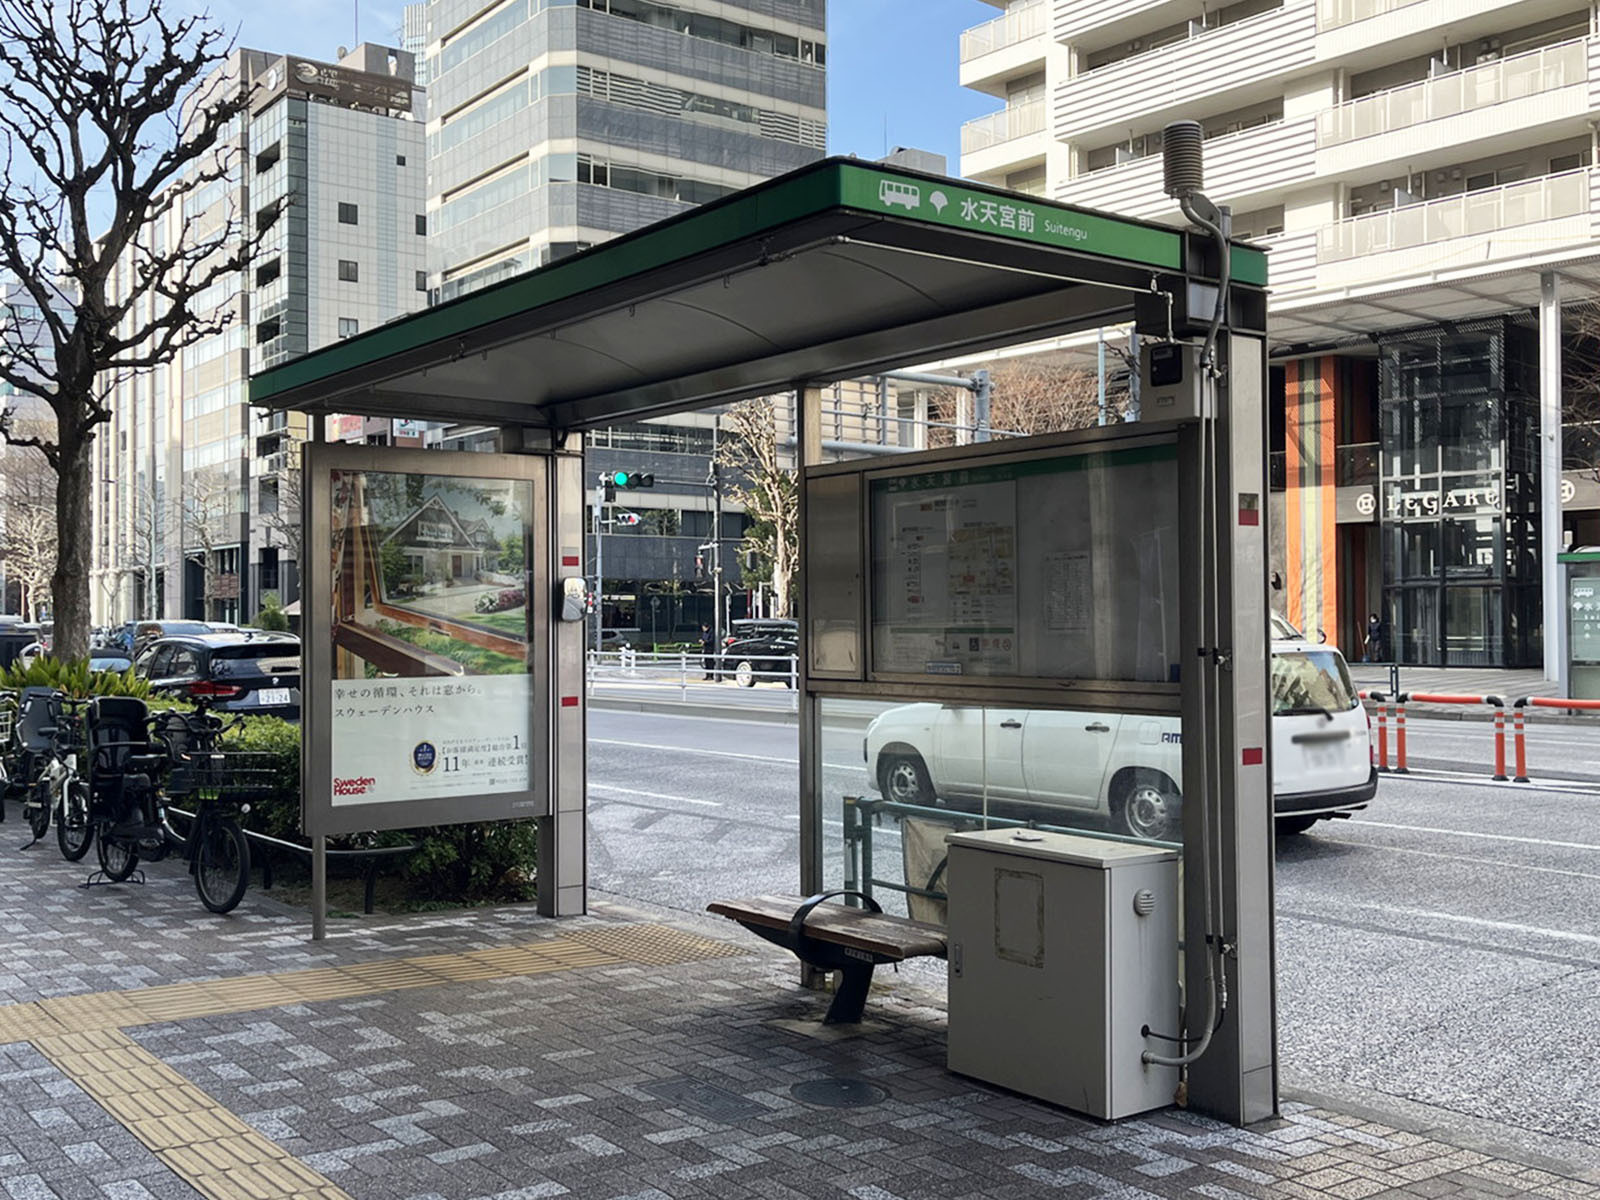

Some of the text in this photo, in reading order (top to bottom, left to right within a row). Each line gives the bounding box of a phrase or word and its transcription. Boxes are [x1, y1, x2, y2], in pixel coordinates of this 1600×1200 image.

[960, 197, 1087, 241] 水天宮前 Suitengu
[334, 704, 435, 718] スウェーデンハウス
[333, 776, 376, 787] Sweden
[333, 785, 367, 796] House
